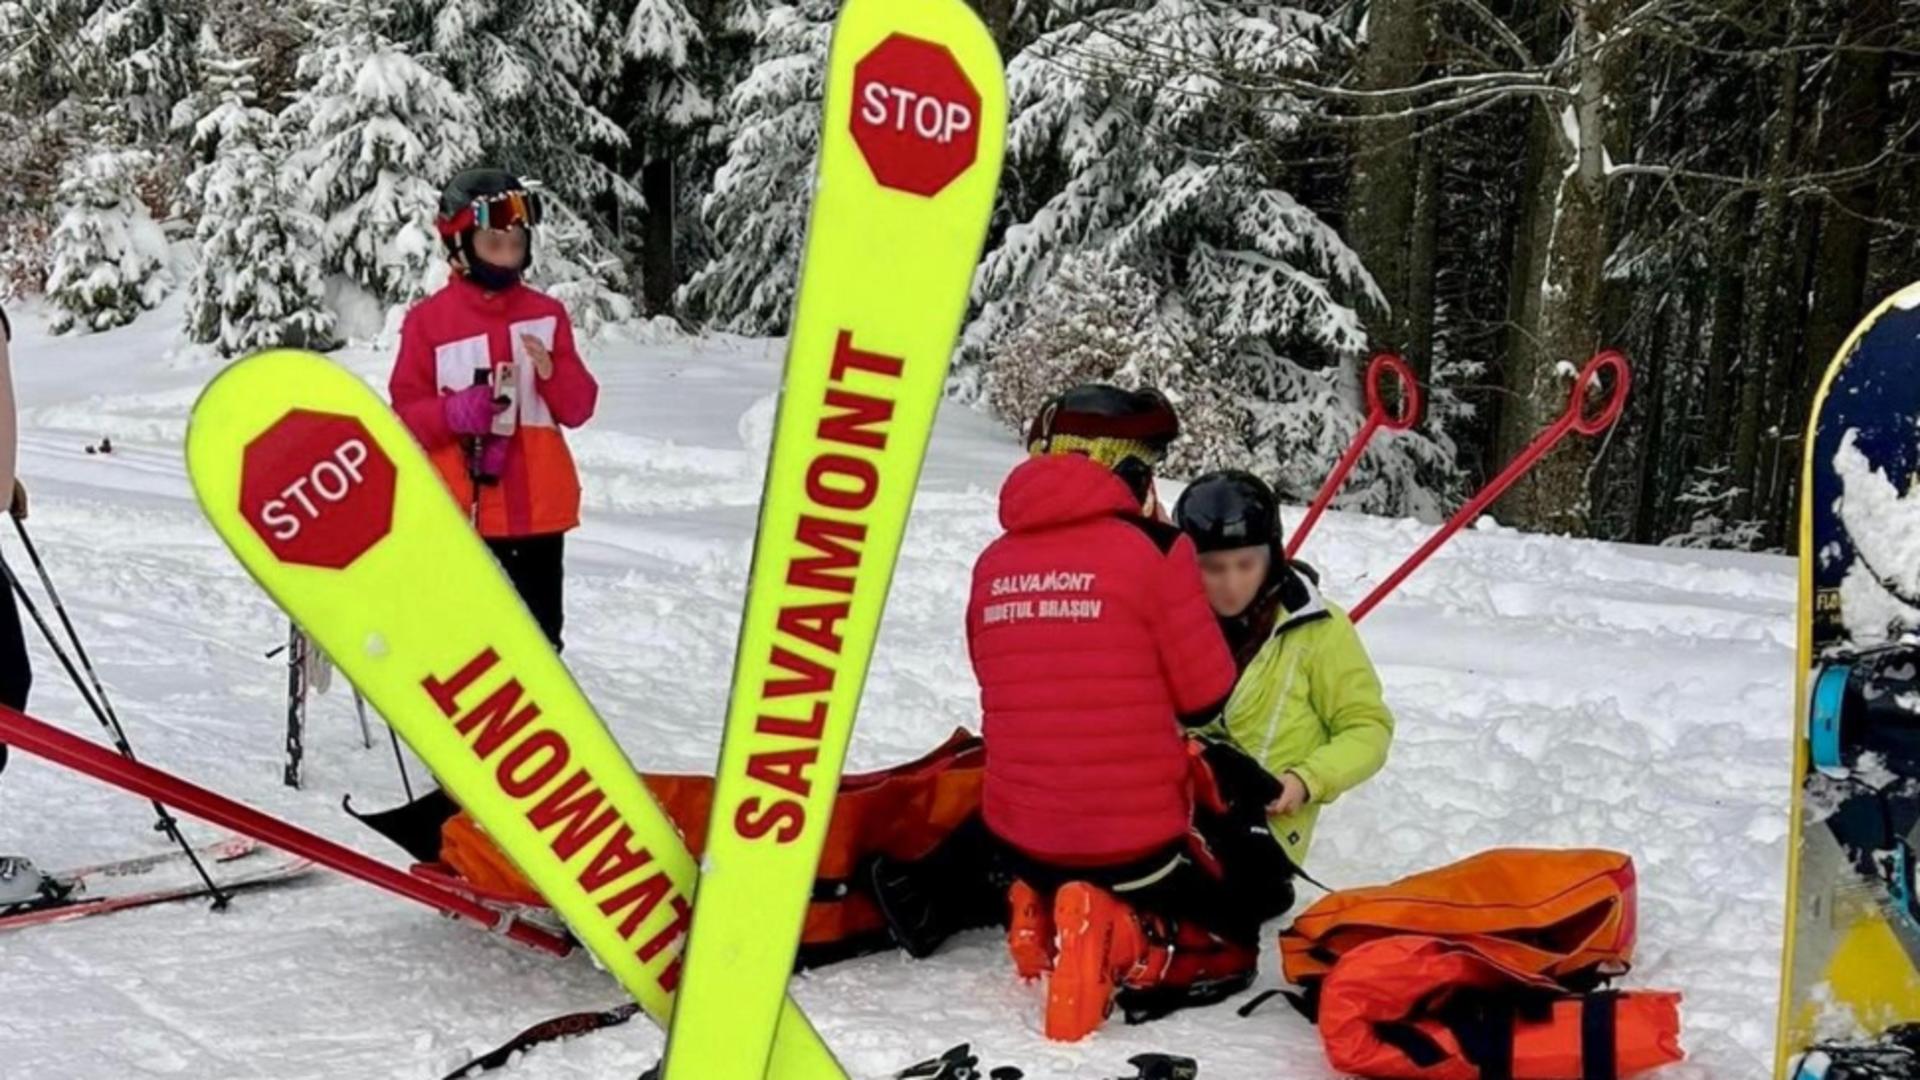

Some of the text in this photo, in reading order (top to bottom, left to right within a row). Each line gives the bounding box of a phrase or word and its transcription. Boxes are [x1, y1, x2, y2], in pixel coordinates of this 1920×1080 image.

[861, 82, 972, 143] STOP
[261, 438, 369, 541] STOP
[734, 329, 905, 844] SALVAMONT
[991, 570, 1095, 596] SALVAMONT
[421, 647, 692, 994] LVAMONT
